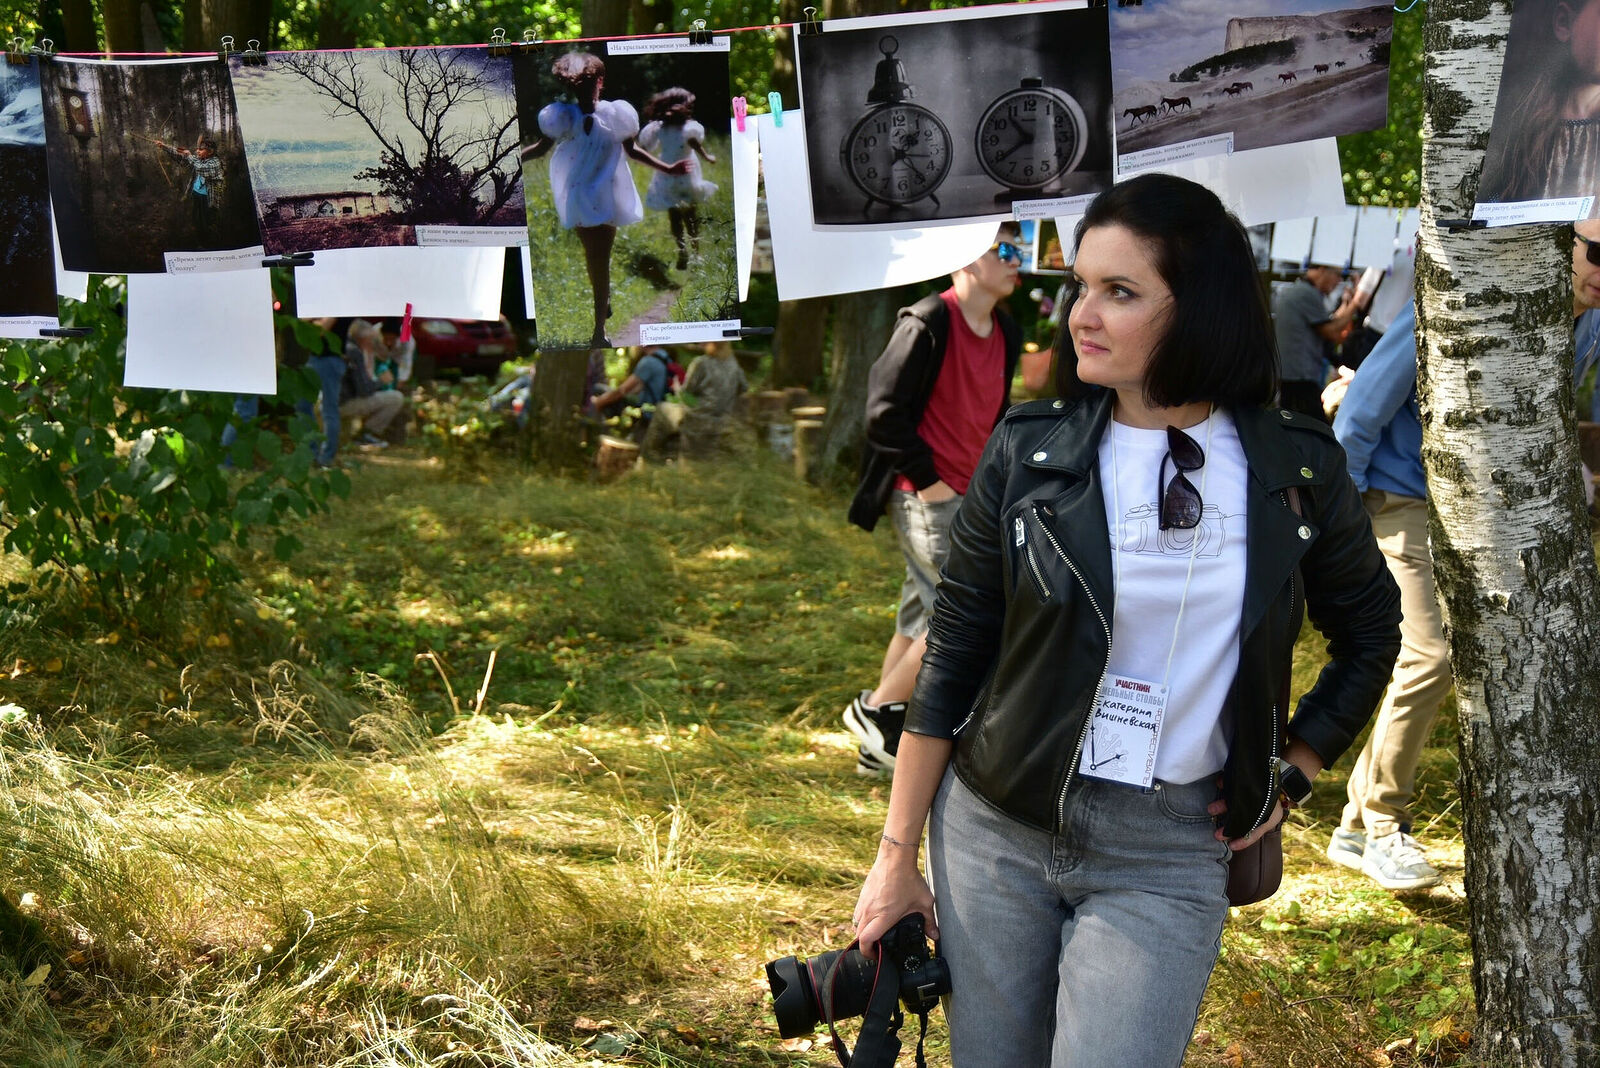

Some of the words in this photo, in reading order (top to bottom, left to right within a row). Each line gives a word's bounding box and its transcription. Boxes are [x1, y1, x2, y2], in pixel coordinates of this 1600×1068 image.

[1024, 100, 1036, 112] 12
[892, 115, 906, 128] 12
[1024, 165, 1034, 178] 6
[1040, 160, 1050, 172] 5
[1115, 679, 1151, 693] УЧАСТНИК
[1101, 686, 1134, 700] МЕЛЬНЫЕ
[1136, 692, 1164, 707] СТОЛБЫ
